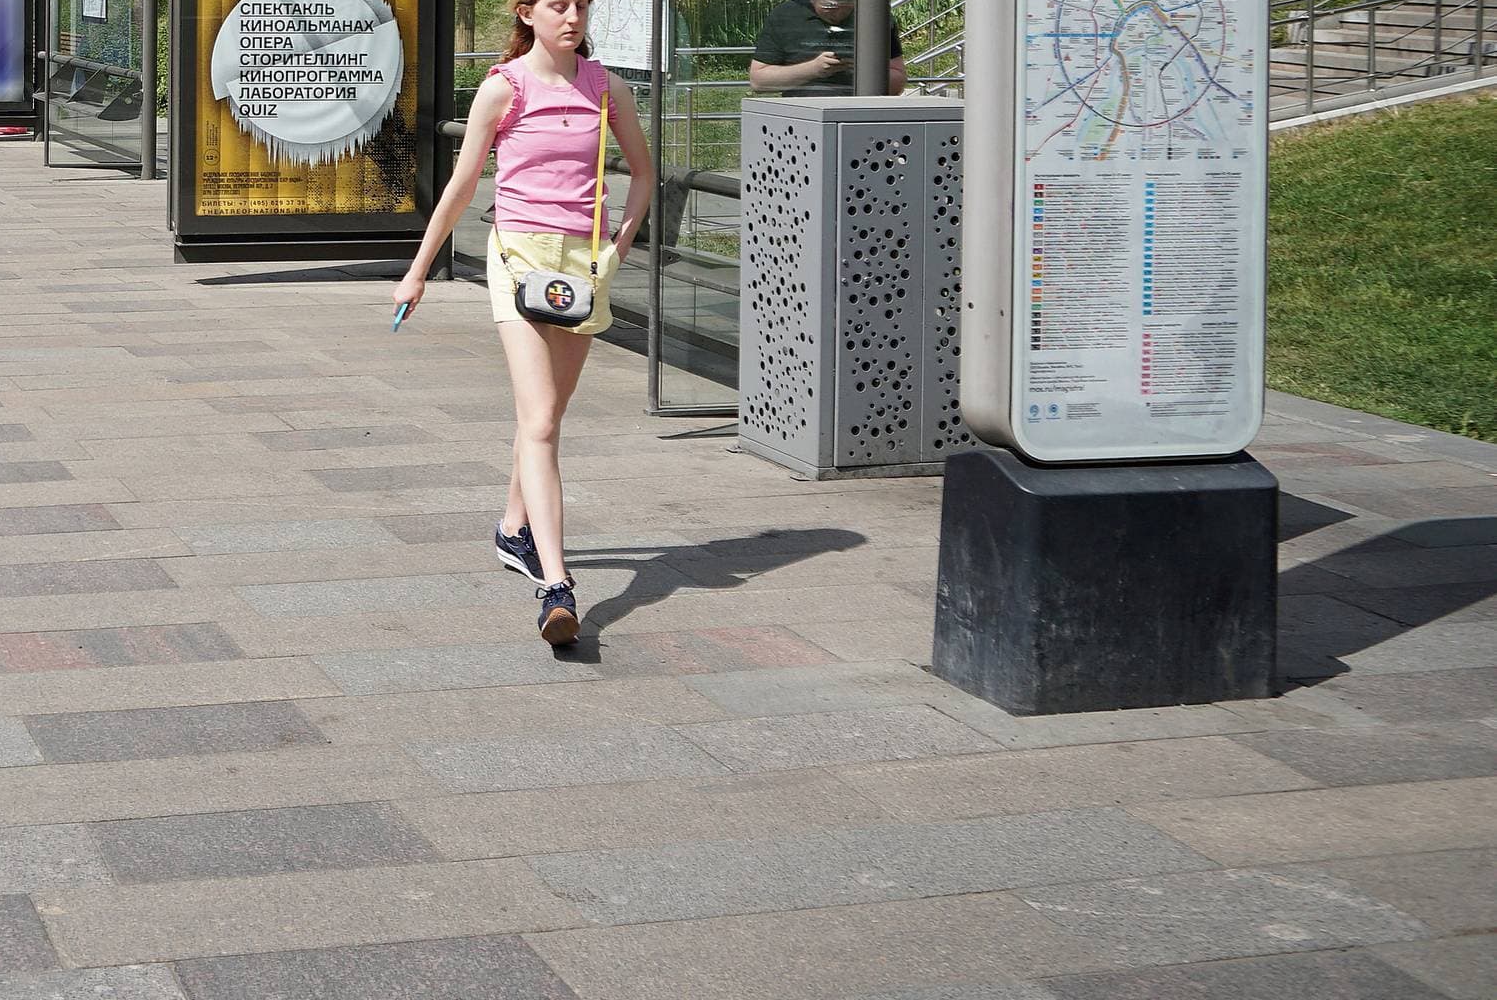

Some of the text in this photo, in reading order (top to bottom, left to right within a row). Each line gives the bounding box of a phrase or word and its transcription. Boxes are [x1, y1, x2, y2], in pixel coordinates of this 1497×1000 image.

[240, 3, 335, 15] СПЕКТАКЛЬ
[240, 20, 374, 32] КИНОАЛЬМАНАХ
[240, 37, 293, 48] ОПЕРА
[240, 53, 368, 65] СТОРИТЕЛЛИНГ
[240, 70, 384, 82] КИНОПРОГРАММА
[239, 87, 357, 99] ЛАБОРАТОРИЯ
[239, 104, 277, 116] QUIZ
